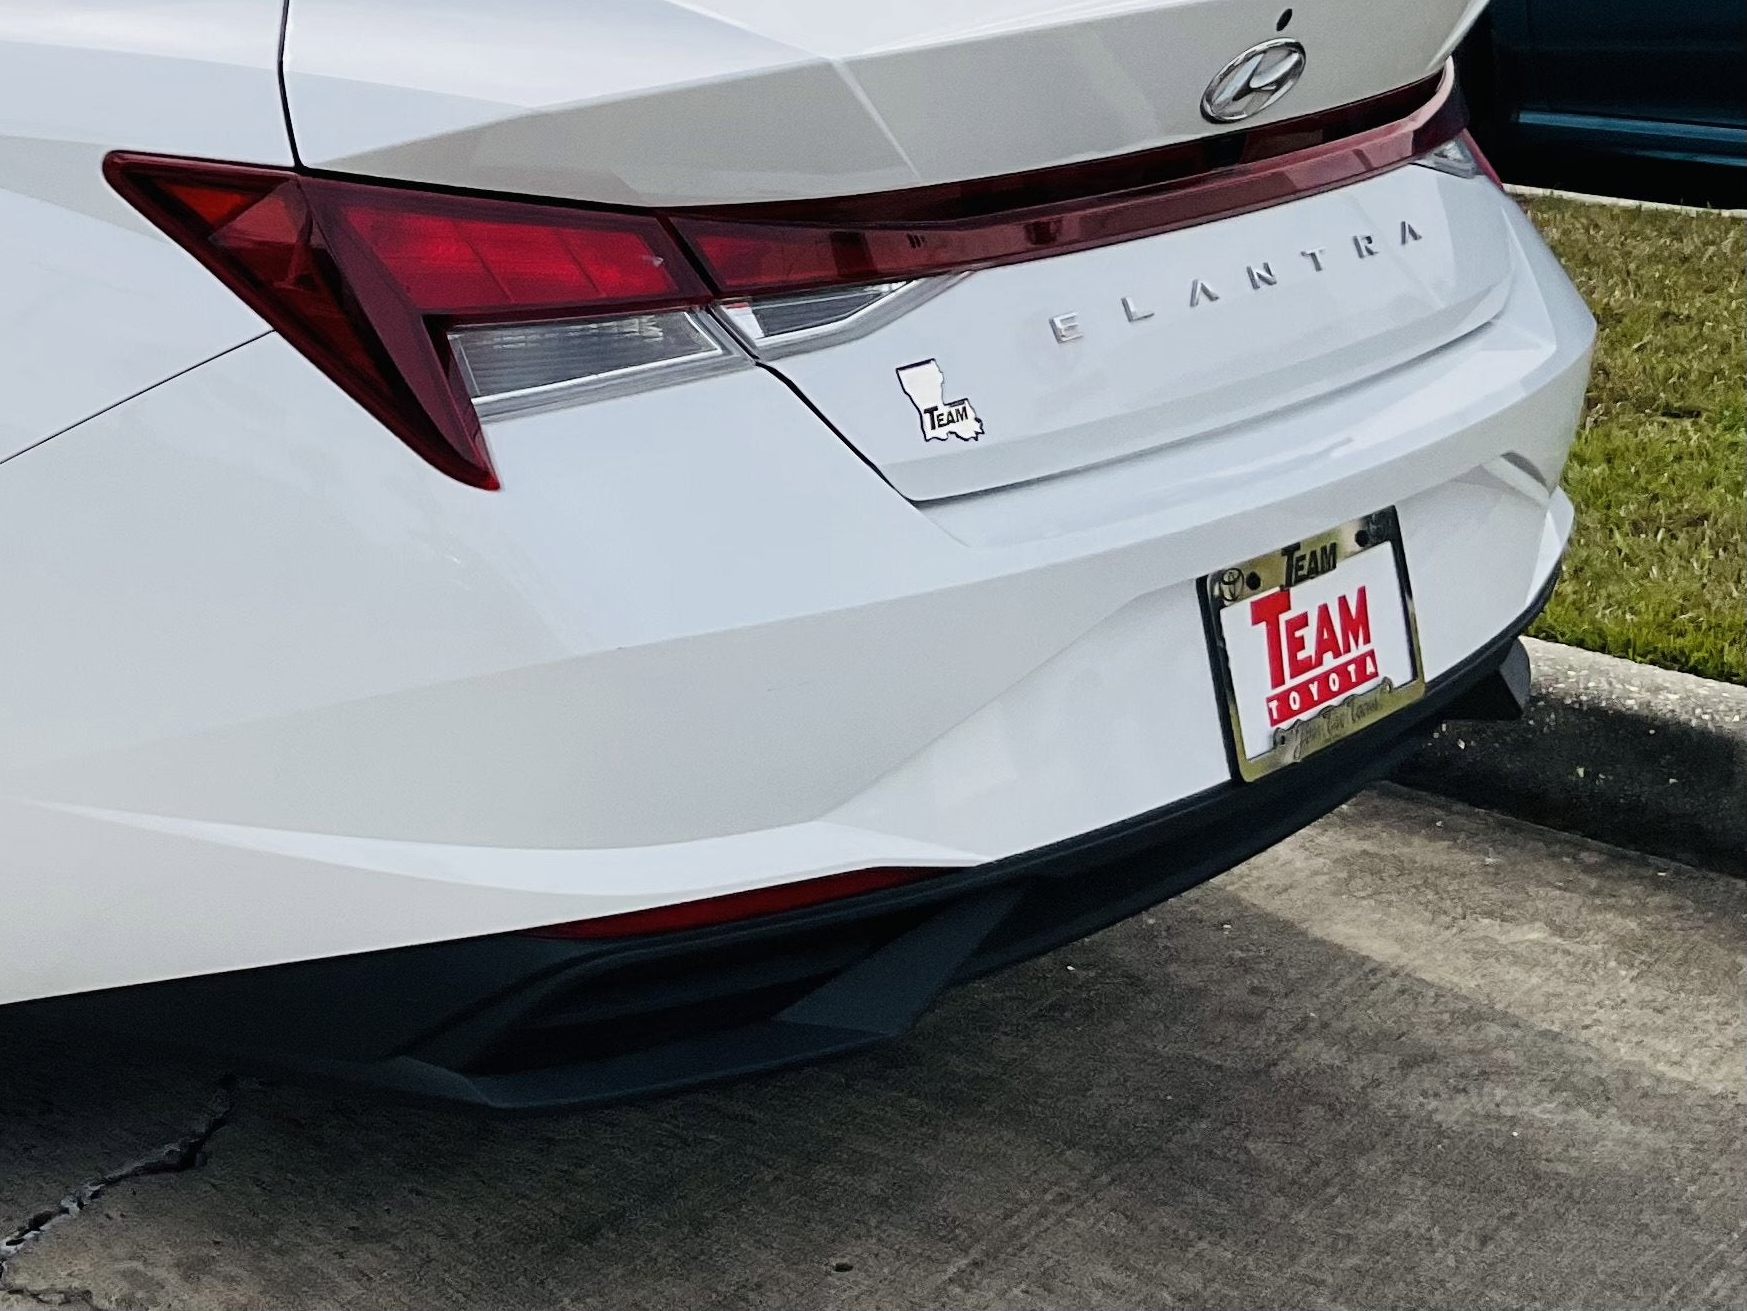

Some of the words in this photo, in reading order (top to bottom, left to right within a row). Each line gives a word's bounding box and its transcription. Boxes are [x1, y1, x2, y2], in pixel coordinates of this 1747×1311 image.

[1049, 220, 1422, 344] ELANTRA
[924, 406, 968, 430] TEAM
[1281, 542, 1337, 589] TEAM
[1250, 585, 1371, 690] TEAM
[1268, 655, 1377, 719] TOYOTA
